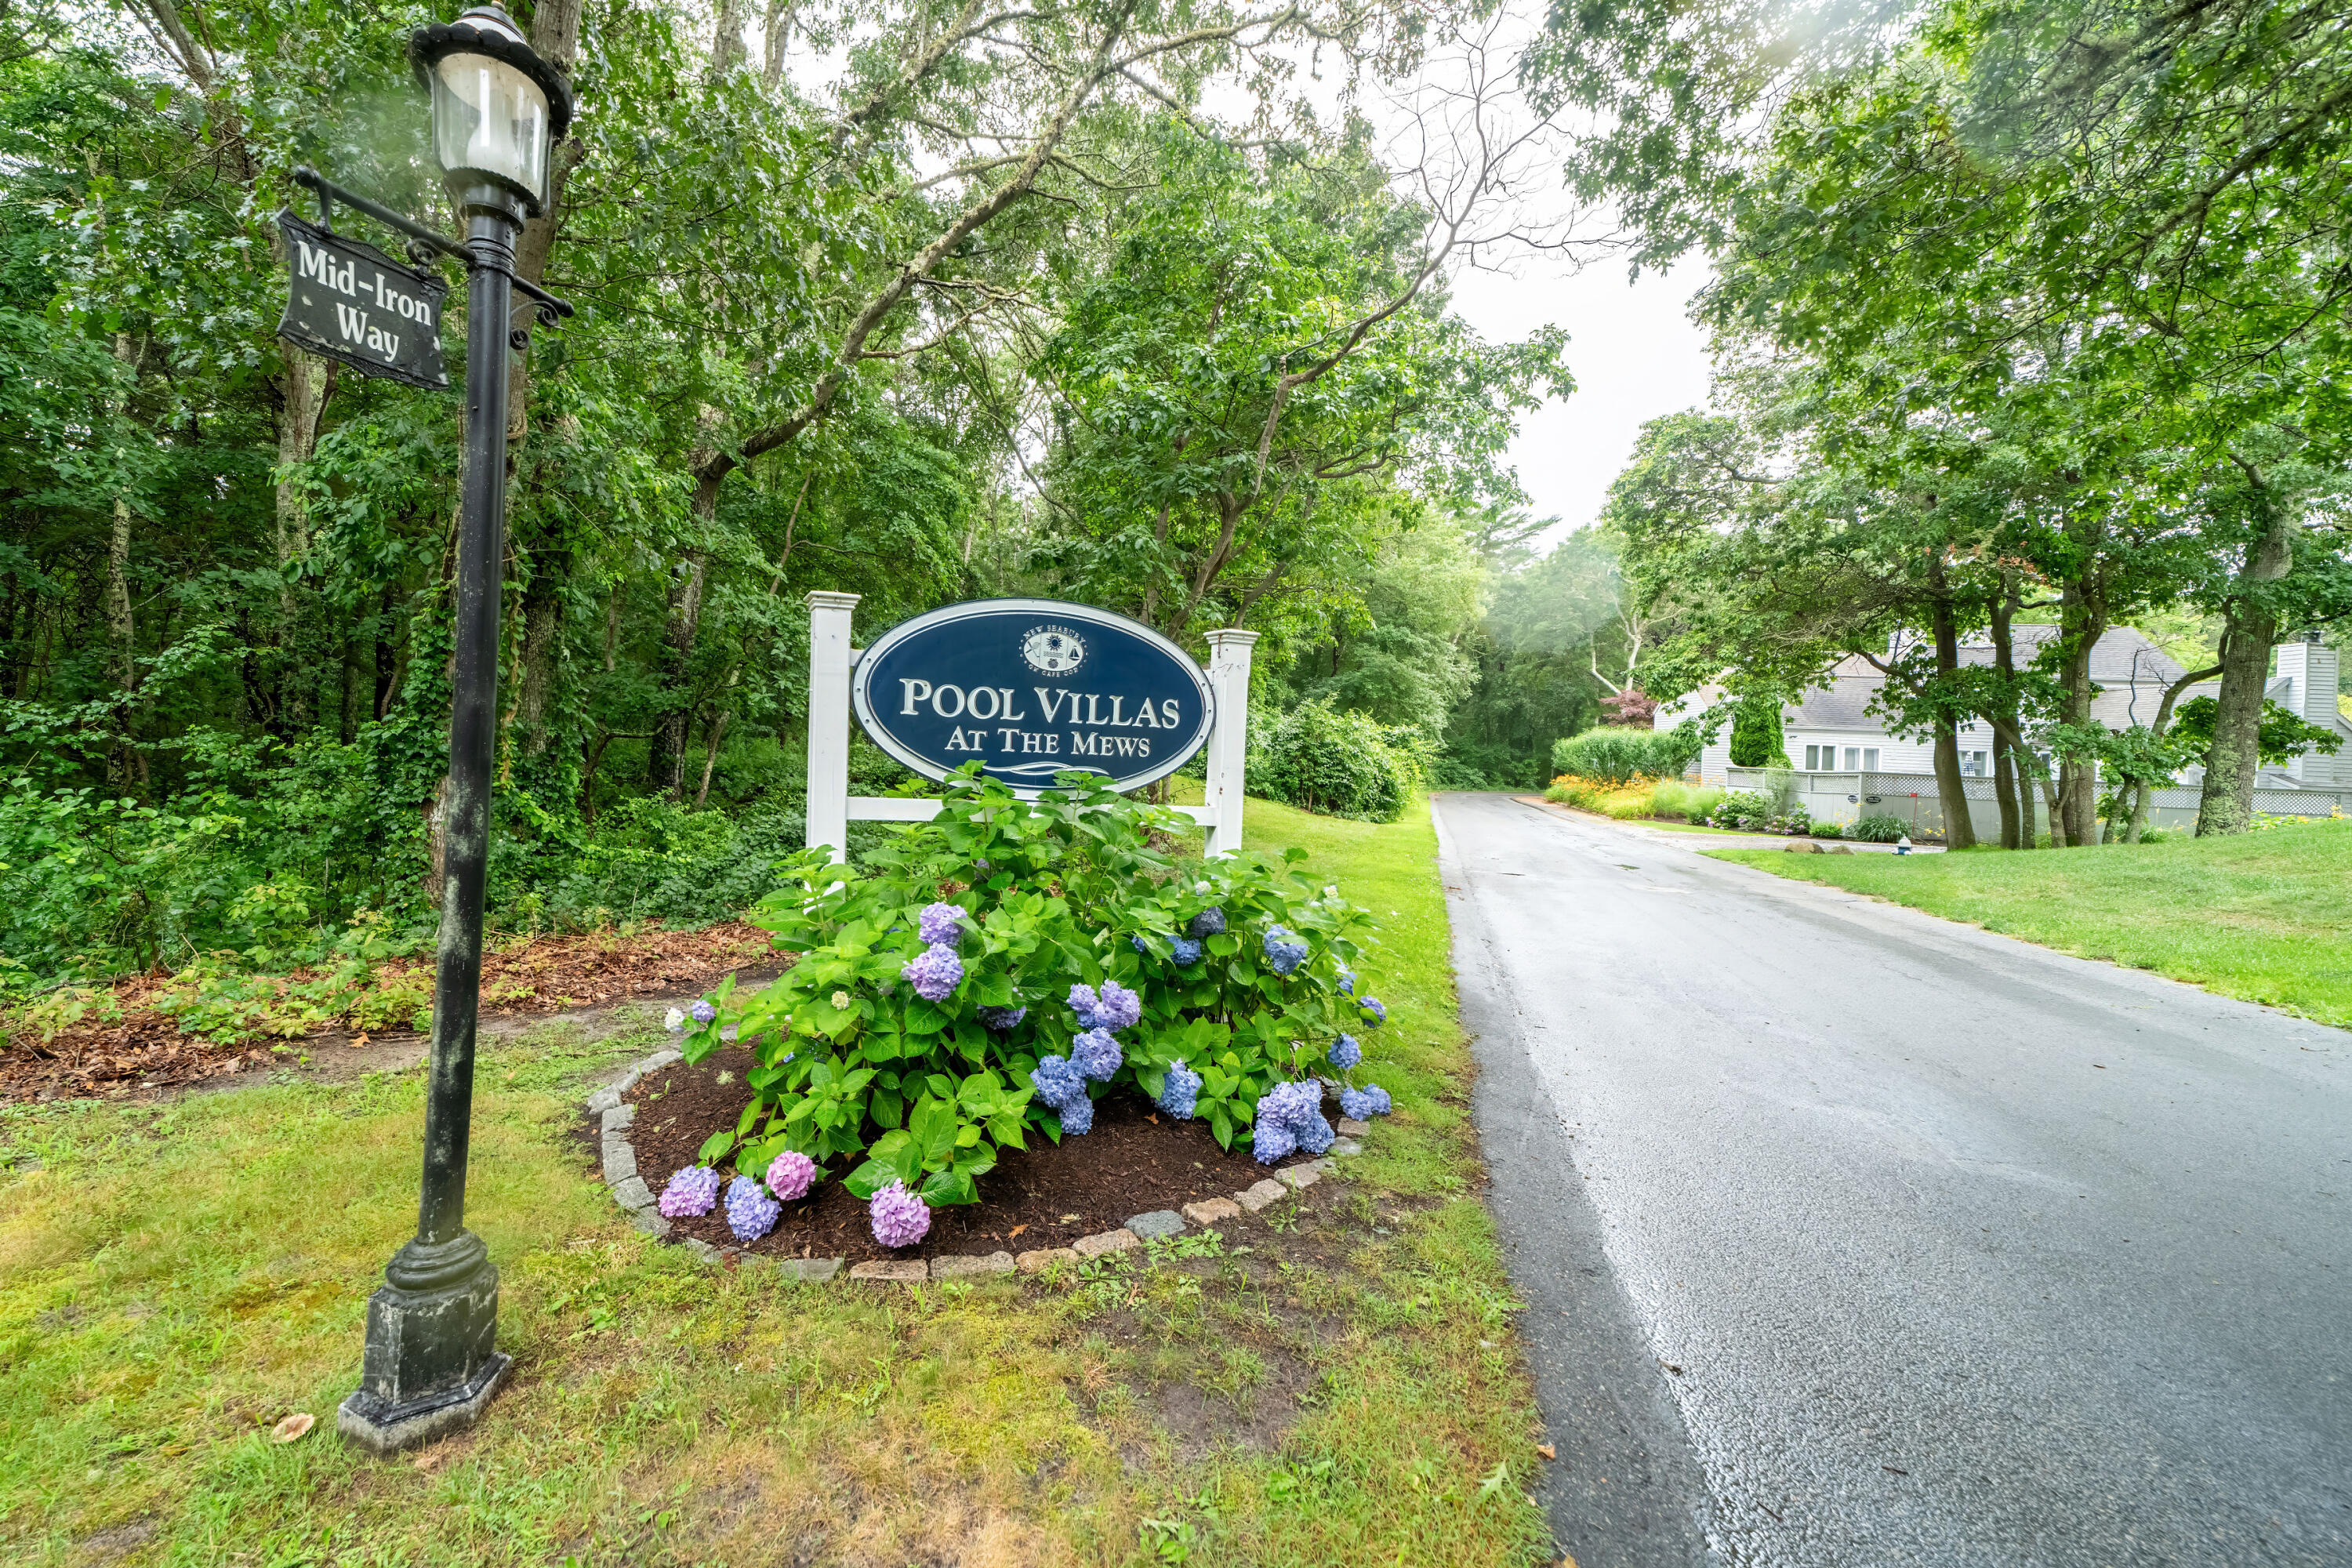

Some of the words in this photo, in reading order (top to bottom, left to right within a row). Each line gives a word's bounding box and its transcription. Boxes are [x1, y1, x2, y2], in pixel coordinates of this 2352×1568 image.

[297, 240, 432, 326] Mid-Iron
[336, 303, 400, 362] Way
[1023, 626, 1044, 640] NEW
[1047, 625, 1087, 644] SEABURY
[898, 678, 1026, 720] POOL
[1033, 687, 1181, 729] VILLAS
[944, 725, 989, 751] AT
[997, 728, 1061, 754] THE
[1070, 731, 1152, 757] MEWS
